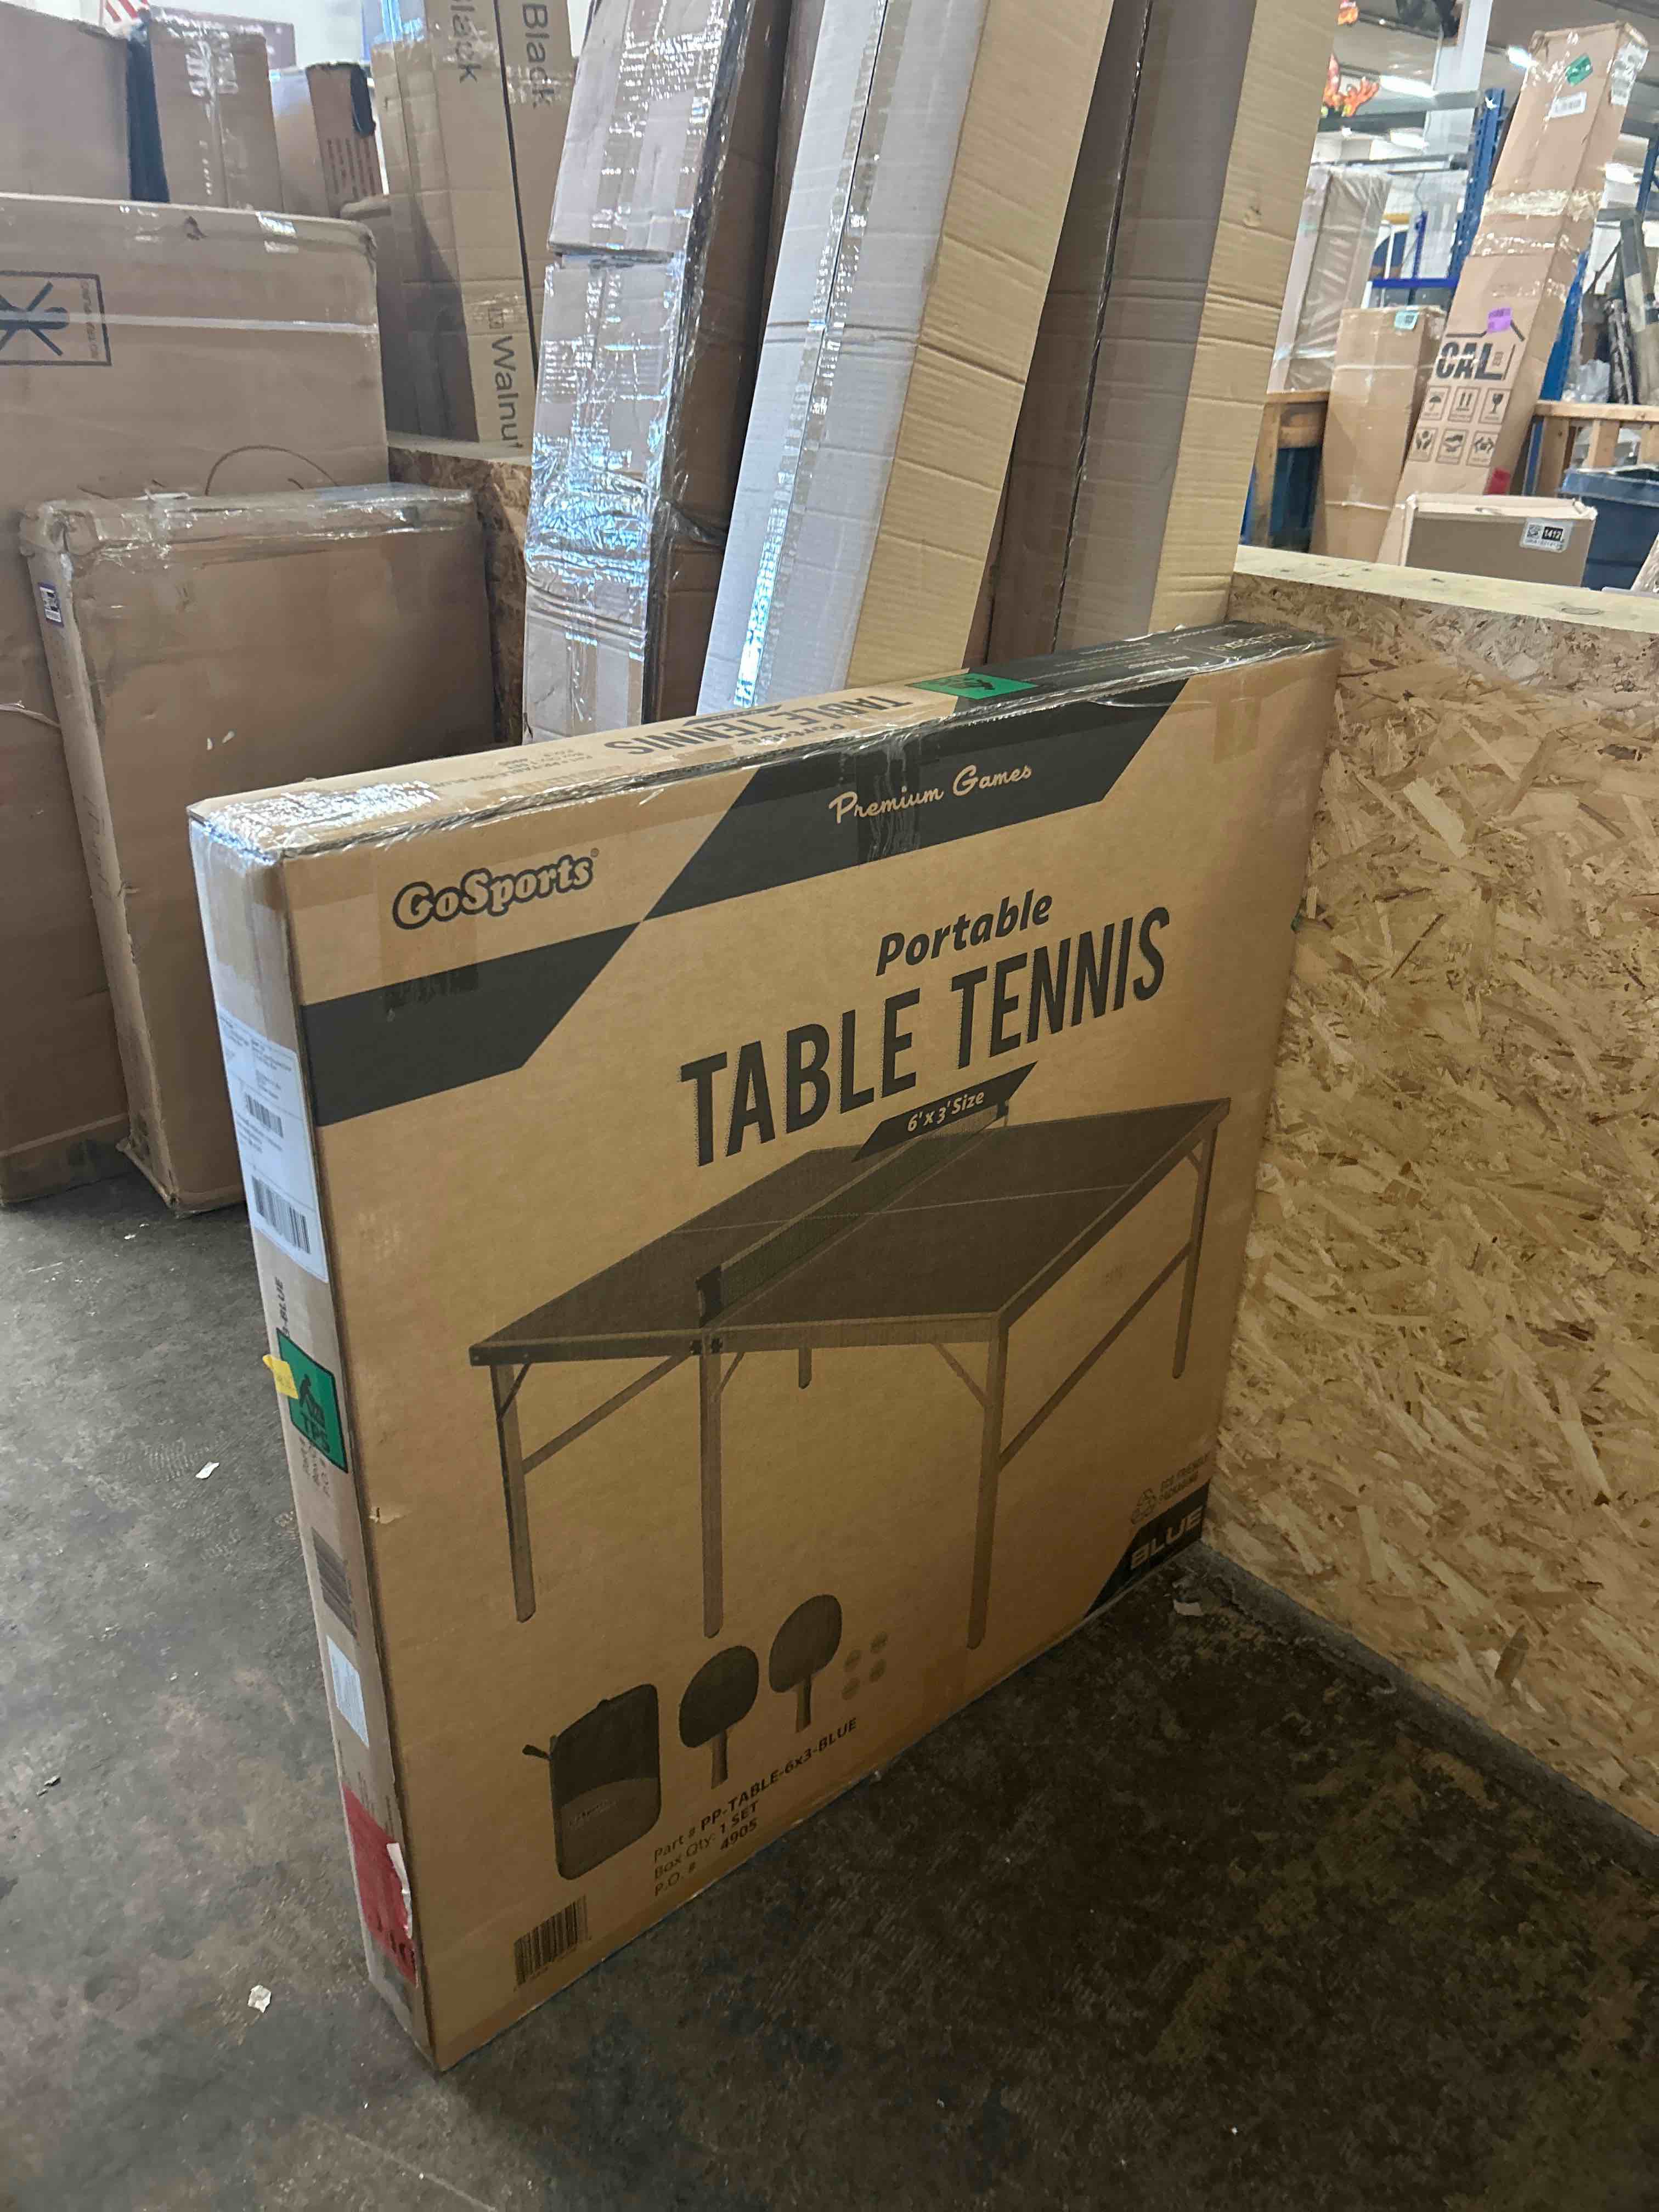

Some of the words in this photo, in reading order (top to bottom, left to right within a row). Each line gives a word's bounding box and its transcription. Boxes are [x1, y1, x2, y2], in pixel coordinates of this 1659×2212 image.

[450, 0, 478, 83] lack
[522, 3, 555, 109] Black
[604, 719, 784, 754] TENNIS
[788, 695, 913, 720] TABLE
[828, 785, 945, 824] Premium
[952, 764, 1032, 797] Games
[392, 854, 594, 930] GoSports
[876, 888, 1053, 977] Portable
[679, 988, 921, 1167] TABLE
[951, 906, 1171, 1070] TENNIS
[654, 1835, 684, 1864] Part
[700, 1717, 857, 1832] PP-TABLE-6x3-BLUE
[654, 1857, 681, 1881] Box
[686, 1832, 716, 1858] Qty:
[731, 1799, 759, 1827] SET
[654, 1871, 684, 1897] P.O.
[720, 1817, 757, 1850] 4905
